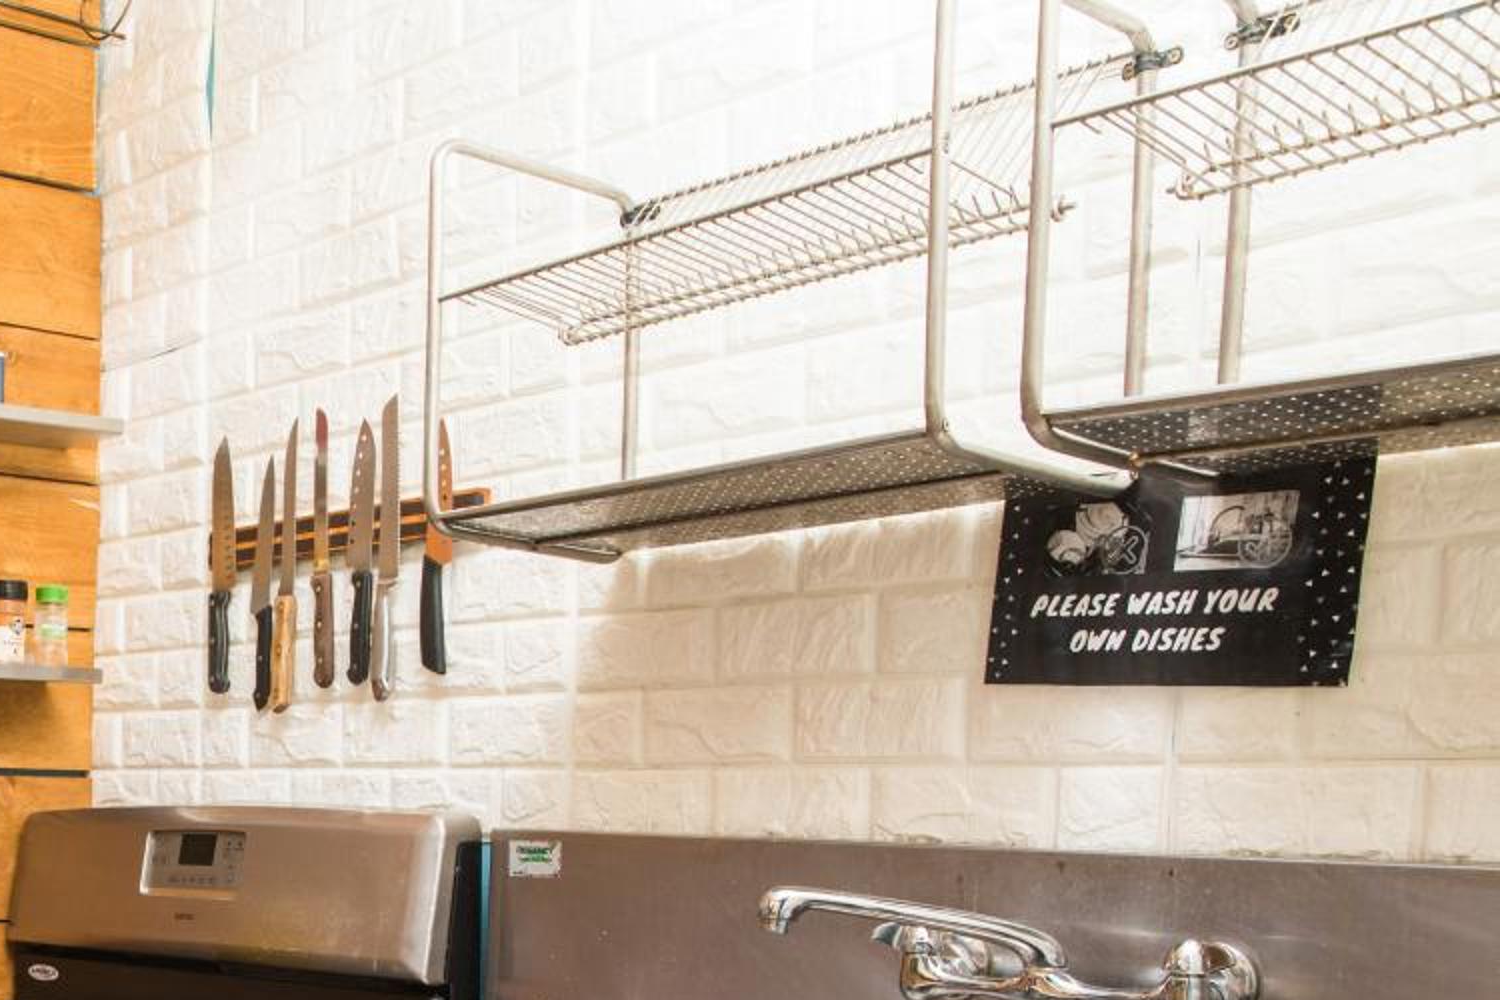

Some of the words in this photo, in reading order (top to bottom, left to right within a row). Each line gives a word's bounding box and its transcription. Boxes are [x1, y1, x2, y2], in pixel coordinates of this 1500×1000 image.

[1030, 592, 1121, 618] PLEASE
[1127, 590, 1199, 616] WASH
[1202, 587, 1279, 615] YOUR
[1069, 628, 1127, 653] OWN
[1131, 626, 1226, 652] DISHES
